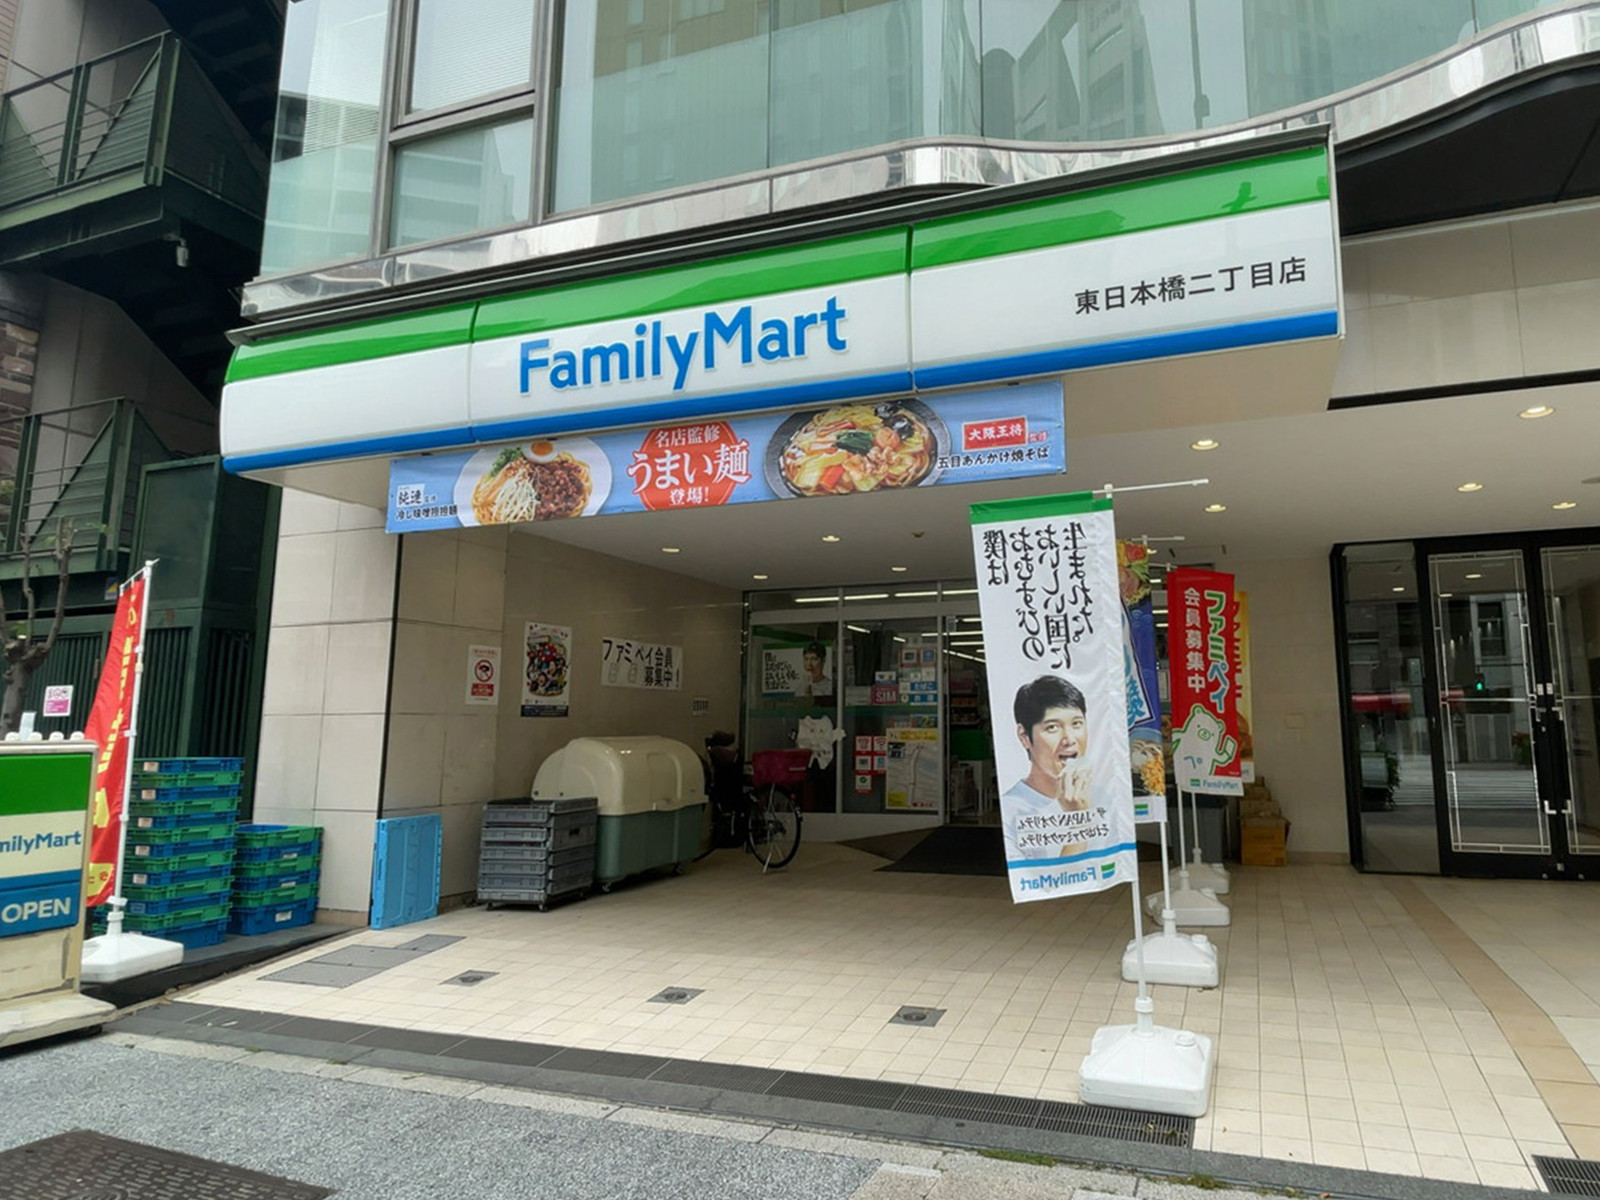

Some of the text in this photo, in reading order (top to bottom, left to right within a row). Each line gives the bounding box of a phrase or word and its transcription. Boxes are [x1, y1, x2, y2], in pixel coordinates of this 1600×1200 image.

[1075, 257, 1306, 315] 東日本橋二丁目店
[519, 295, 848, 394] FamilyMart
[656, 425, 721, 448] 名店監修
[968, 423, 1024, 441] 大阪王将
[627, 439, 752, 494] うまい麺
[938, 447, 1049, 468] 五目あんかけ焼そば
[1184, 588, 1206, 693] 会員募集中
[1204, 589, 1229, 713] ファミペイ
[875, 690, 897, 703] SIM
[1, 897, 71, 923] OPEN
